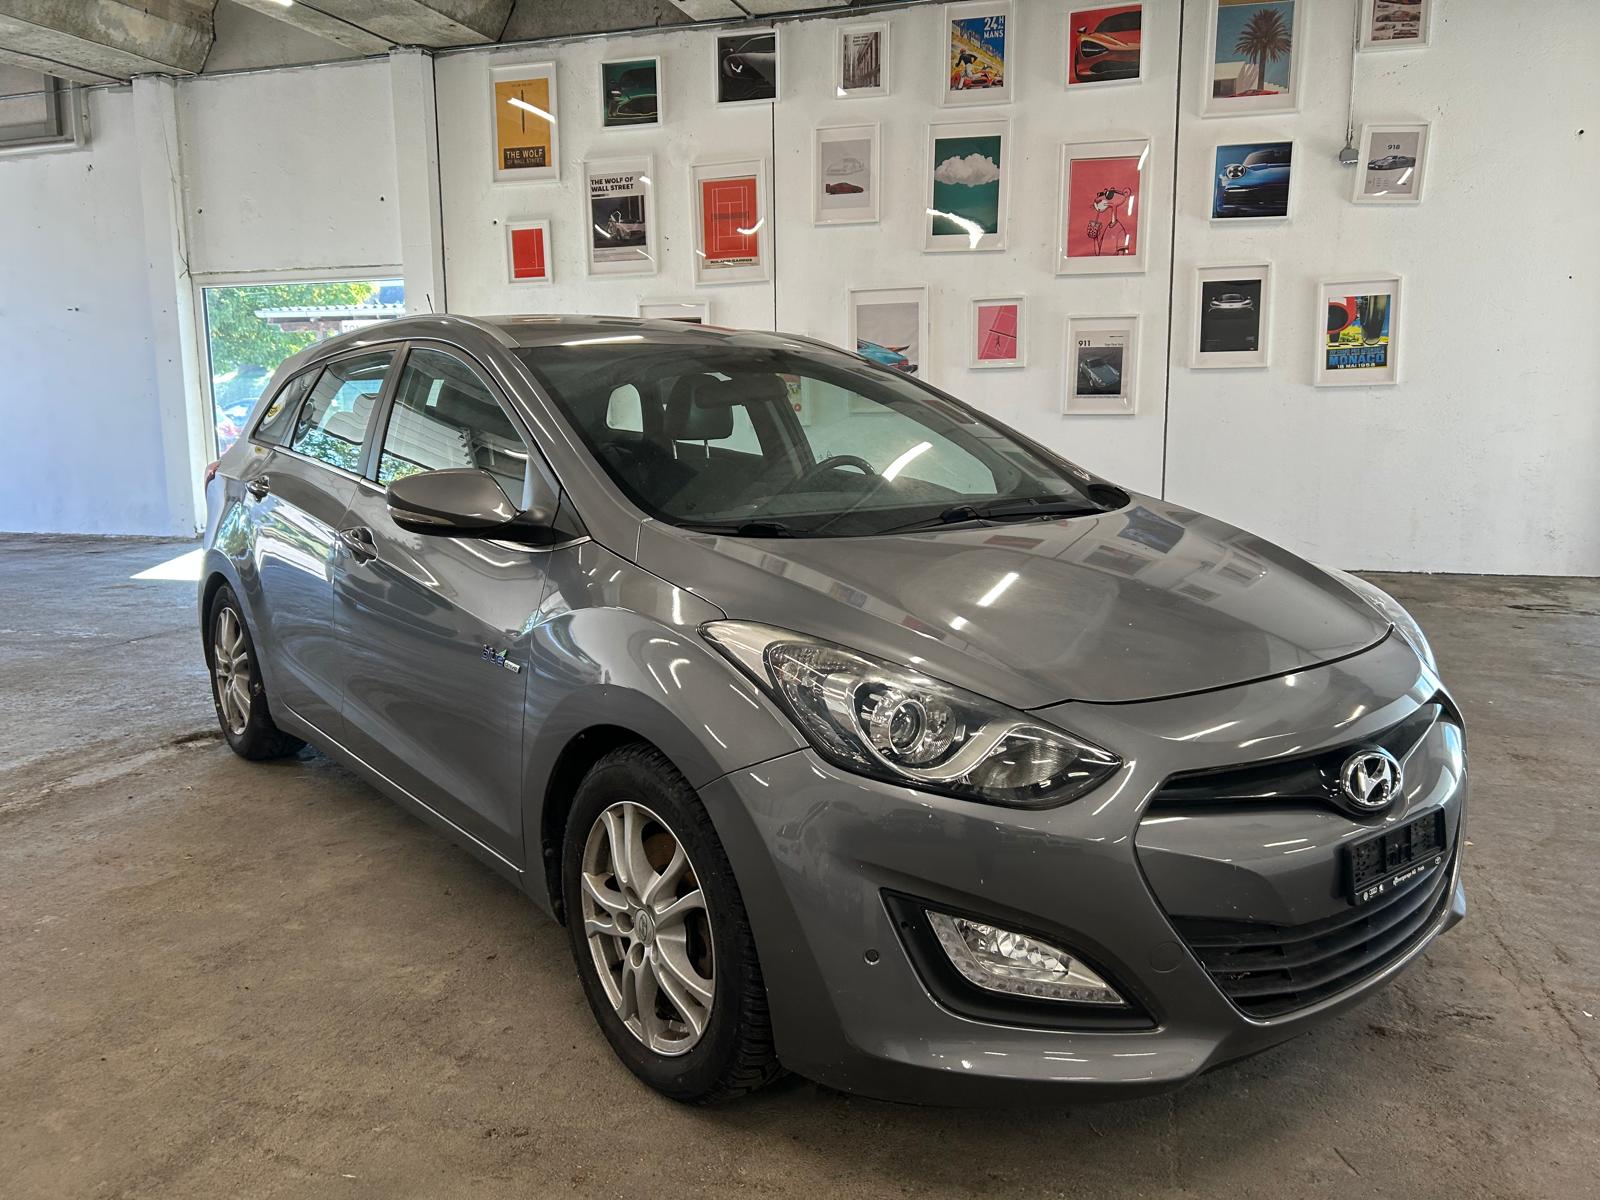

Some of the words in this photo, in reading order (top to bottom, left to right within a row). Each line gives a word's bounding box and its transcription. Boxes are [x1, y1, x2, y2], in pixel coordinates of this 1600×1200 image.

[984, 17, 998, 30] 24
[984, 30, 1004, 39] MANS
[506, 151, 521, 159] THE
[522, 149, 543, 157] WOLF
[1328, 354, 1385, 365] MONACO
